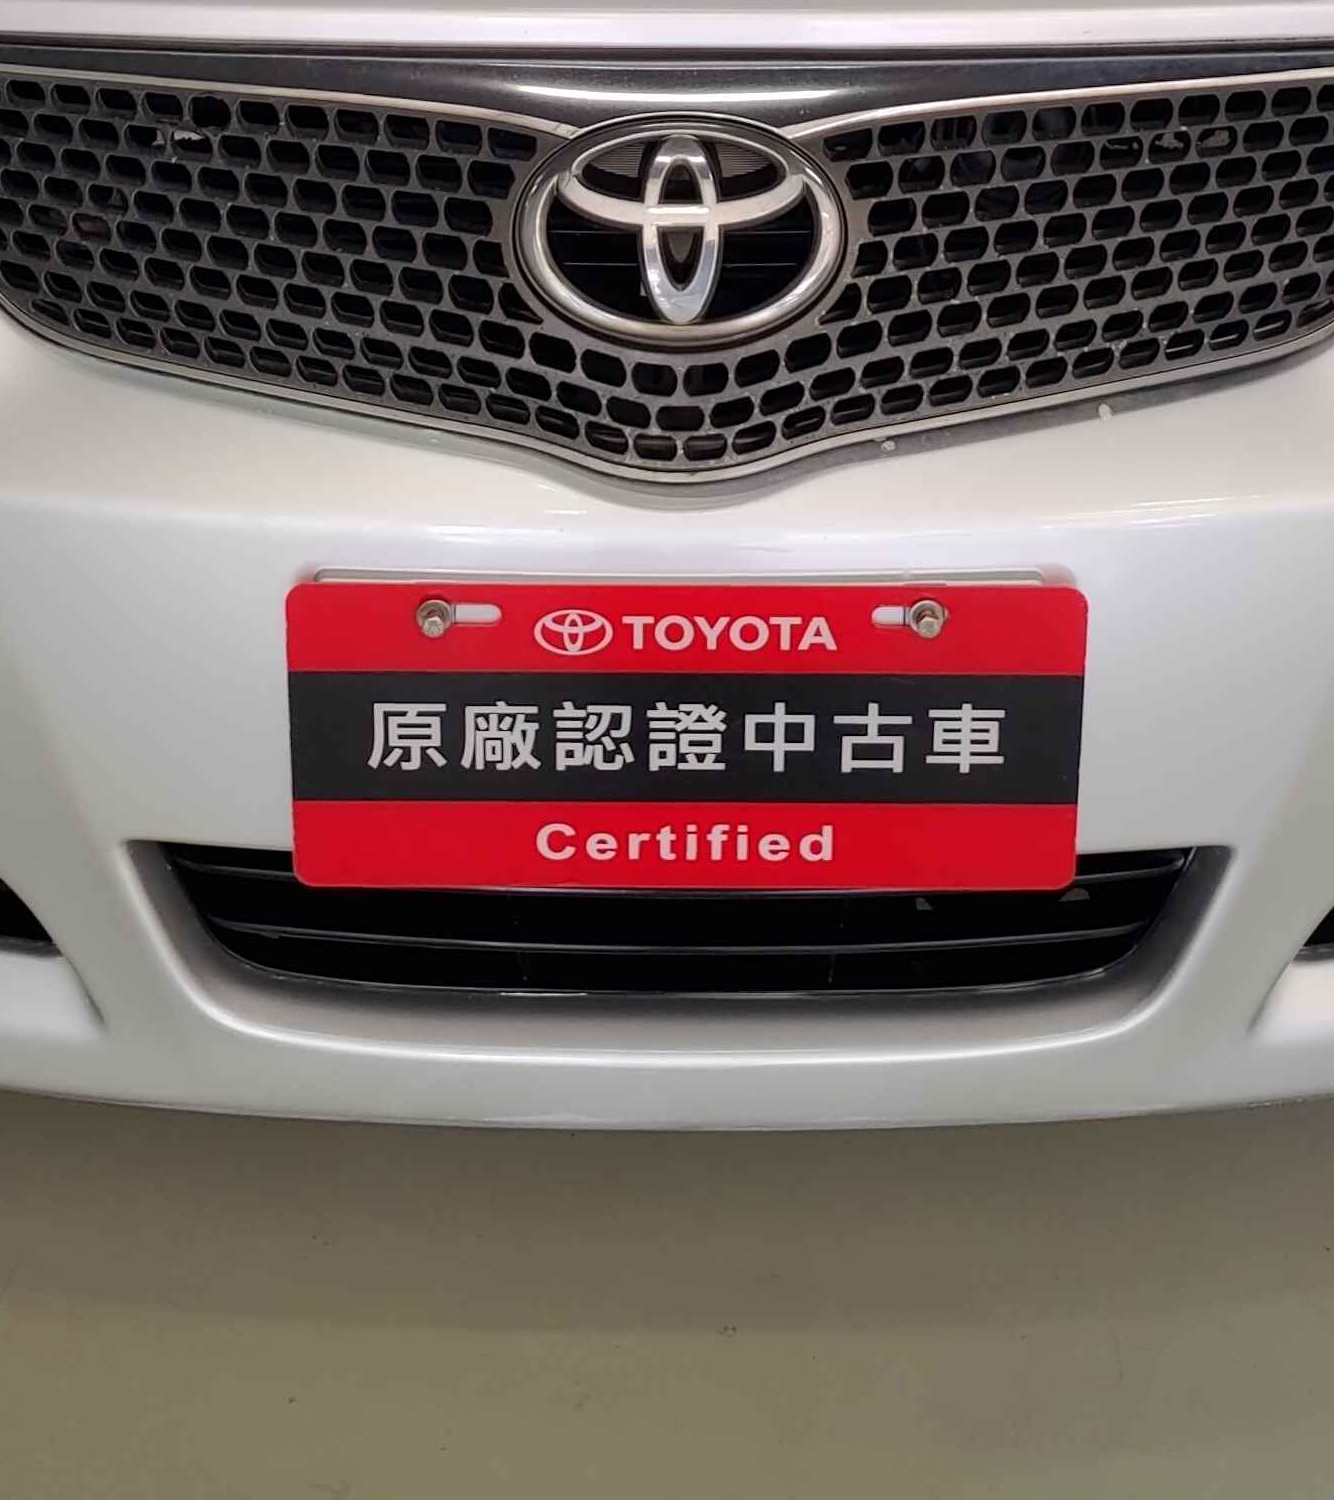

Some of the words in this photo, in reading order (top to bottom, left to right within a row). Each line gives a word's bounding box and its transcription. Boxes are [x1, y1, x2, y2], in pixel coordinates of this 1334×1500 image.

[622, 615, 838, 651] TOYOTA
[367, 700, 1008, 774] 原廠認證中古車
[535, 823, 836, 862] Certified
